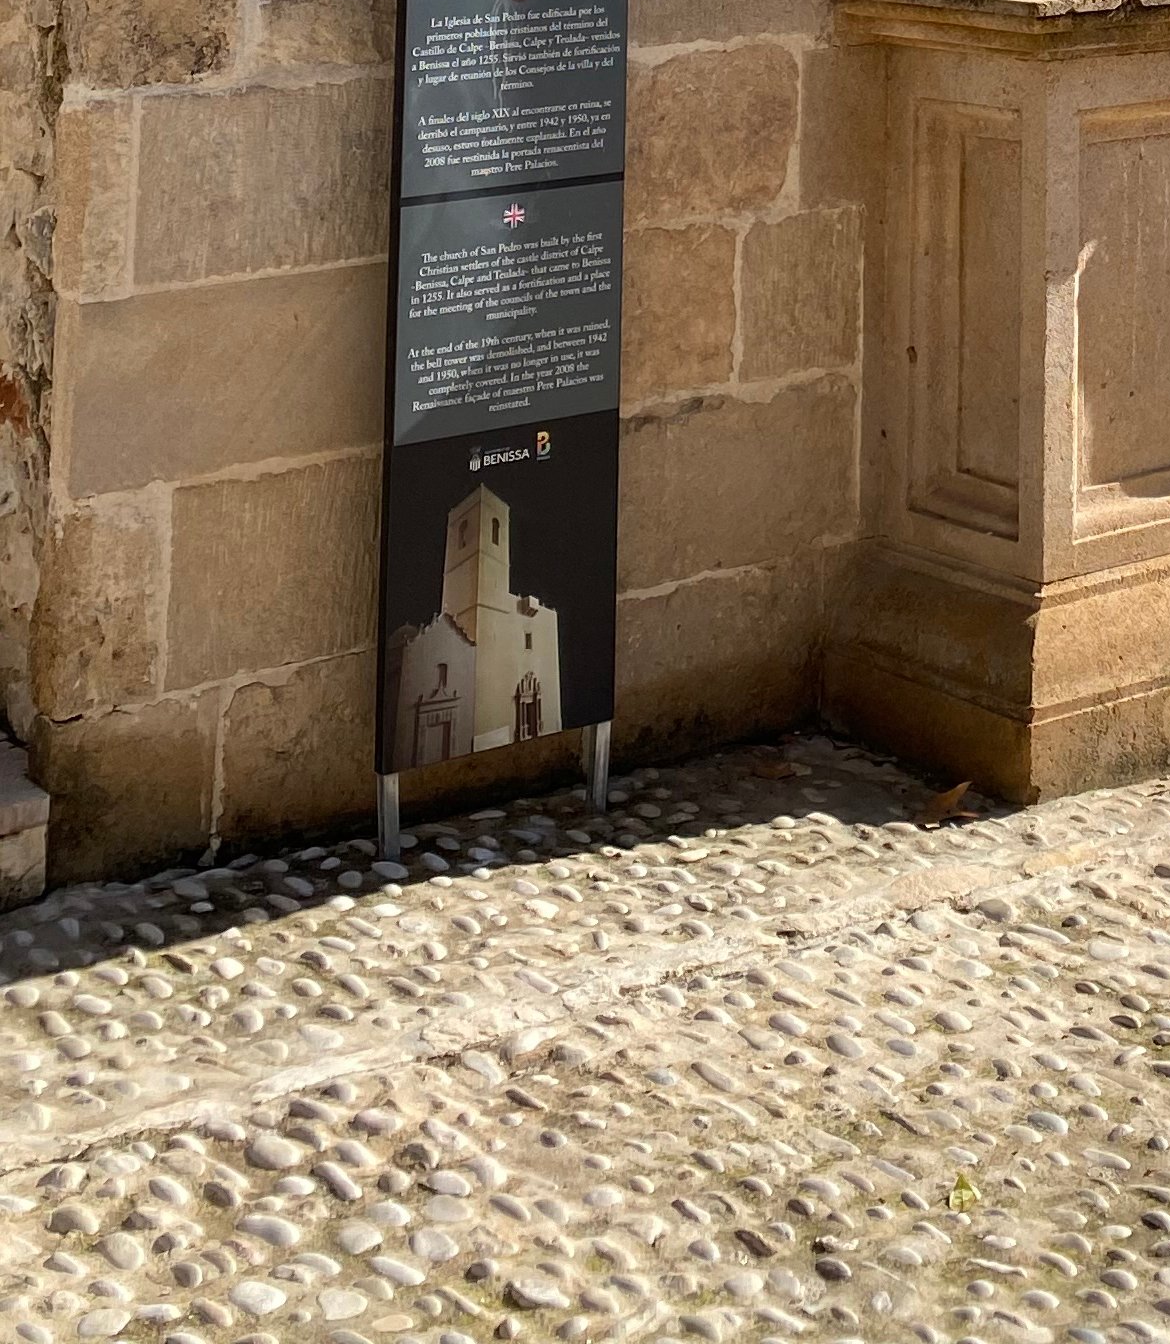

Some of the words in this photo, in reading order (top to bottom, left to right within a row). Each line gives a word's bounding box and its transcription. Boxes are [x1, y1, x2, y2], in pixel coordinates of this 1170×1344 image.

[431, 18, 443, 28] La
[444, 15, 471, 29] Iglesia
[472, 15, 483, 24] de
[485, 13, 500, 23] San
[502, 11, 526, 22] Pedro
[593, 5, 605, 14] los
[426, 31, 463, 44] primeros
[464, 26, 508, 41] pobladores
[510, 23, 548, 34] cristianos
[549, 21, 562, 31] del
[412, 45, 445, 56] Castillo
[446, 44, 457, 53] de
[459, 42, 483, 54] Calpe
[419, 59, 450, 70] Benissa
[451, 57, 460, 67] el
[425, 74, 447, 86] lugar
[448, 72, 459, 81] de
[518, 65, 555, 76] Consejos
[577, 59, 594, 70] villa
[601, 57, 613, 67] del
[417, 116, 426, 126] A
[428, 114, 455, 125] finales
[456, 111, 470, 122] del
[471, 110, 491, 123] siglo
[492, 107, 510, 118] XIX
[512, 106, 520, 116] al
[450, 127, 458, 137] el
[540, 116, 559, 127] 1942
[569, 128, 581, 138] En
[582, 127, 590, 137] el
[424, 156, 446, 167] 2008
[591, 139, 603, 149] del
[419, 264, 459, 277] Christian
[461, 260, 490, 271] settlers
[491, 256, 501, 267] of
[502, 255, 515, 266] the
[517, 252, 539, 264] castle
[540, 248, 569, 260] district
[570, 246, 579, 256] of
[580, 244, 604, 256] Calpe
[422, 252, 438, 263] The
[439, 248, 468, 261] church
[470, 246, 480, 257] of
[480, 245, 497, 255] San
[498, 242, 522, 253] Pedro
[523, 242, 539, 250] was
[540, 237, 559, 248] built
[560, 235, 570, 248] by
[572, 233, 585, 244] the
[587, 232, 602, 242] first
[450, 274, 475, 286] Calpe
[477, 270, 492, 282] and
[531, 264, 547, 274] that
[582, 256, 611, 267] Benissa
[409, 308, 422, 318] for
[423, 306, 438, 316] the
[439, 301, 473, 314] meeting
[474, 298, 485, 309] of
[485, 297, 499, 307] the
[560, 288, 580, 297] town
[598, 281, 612, 291] the
[411, 295, 420, 305] in
[447, 290, 454, 300] It
[456, 288, 473, 298] also
[474, 283, 500, 296] served
[519, 275, 566, 290] fortification
[567, 271, 583, 283] and
[408, 348, 420, 358] At
[421, 345, 435, 356] the
[436, 342, 453, 354] end
[454, 340, 465, 351] of
[465, 339, 479, 349] the
[481, 335, 500, 347] 19th
[535, 328, 557, 339] when
[558, 326, 565, 336] it
[566, 326, 581, 334] was
[411, 361, 425, 372] the
[426, 358, 442, 369] bell
[444, 357, 468, 366] tower
[469, 354, 485, 363] was
[537, 340, 552, 352] and
[553, 338, 586, 349] between
[588, 332, 607, 344] 1942
[417, 372, 434, 384] and
[461, 366, 483, 377] when
[485, 363, 492, 373] it
[493, 363, 509, 372] was
[510, 361, 522, 369] no
[523, 357, 549, 368] longer
[428, 380, 473, 396] completely
[475, 374, 508, 388] covered.
[510, 373, 520, 382] In
[521, 370, 535, 381] the
[555, 363, 575, 375] 2008
[537, 381, 554, 391] Pere
[556, 374, 588, 388] Palacios
[483, 448, 530, 467] BENISSA
